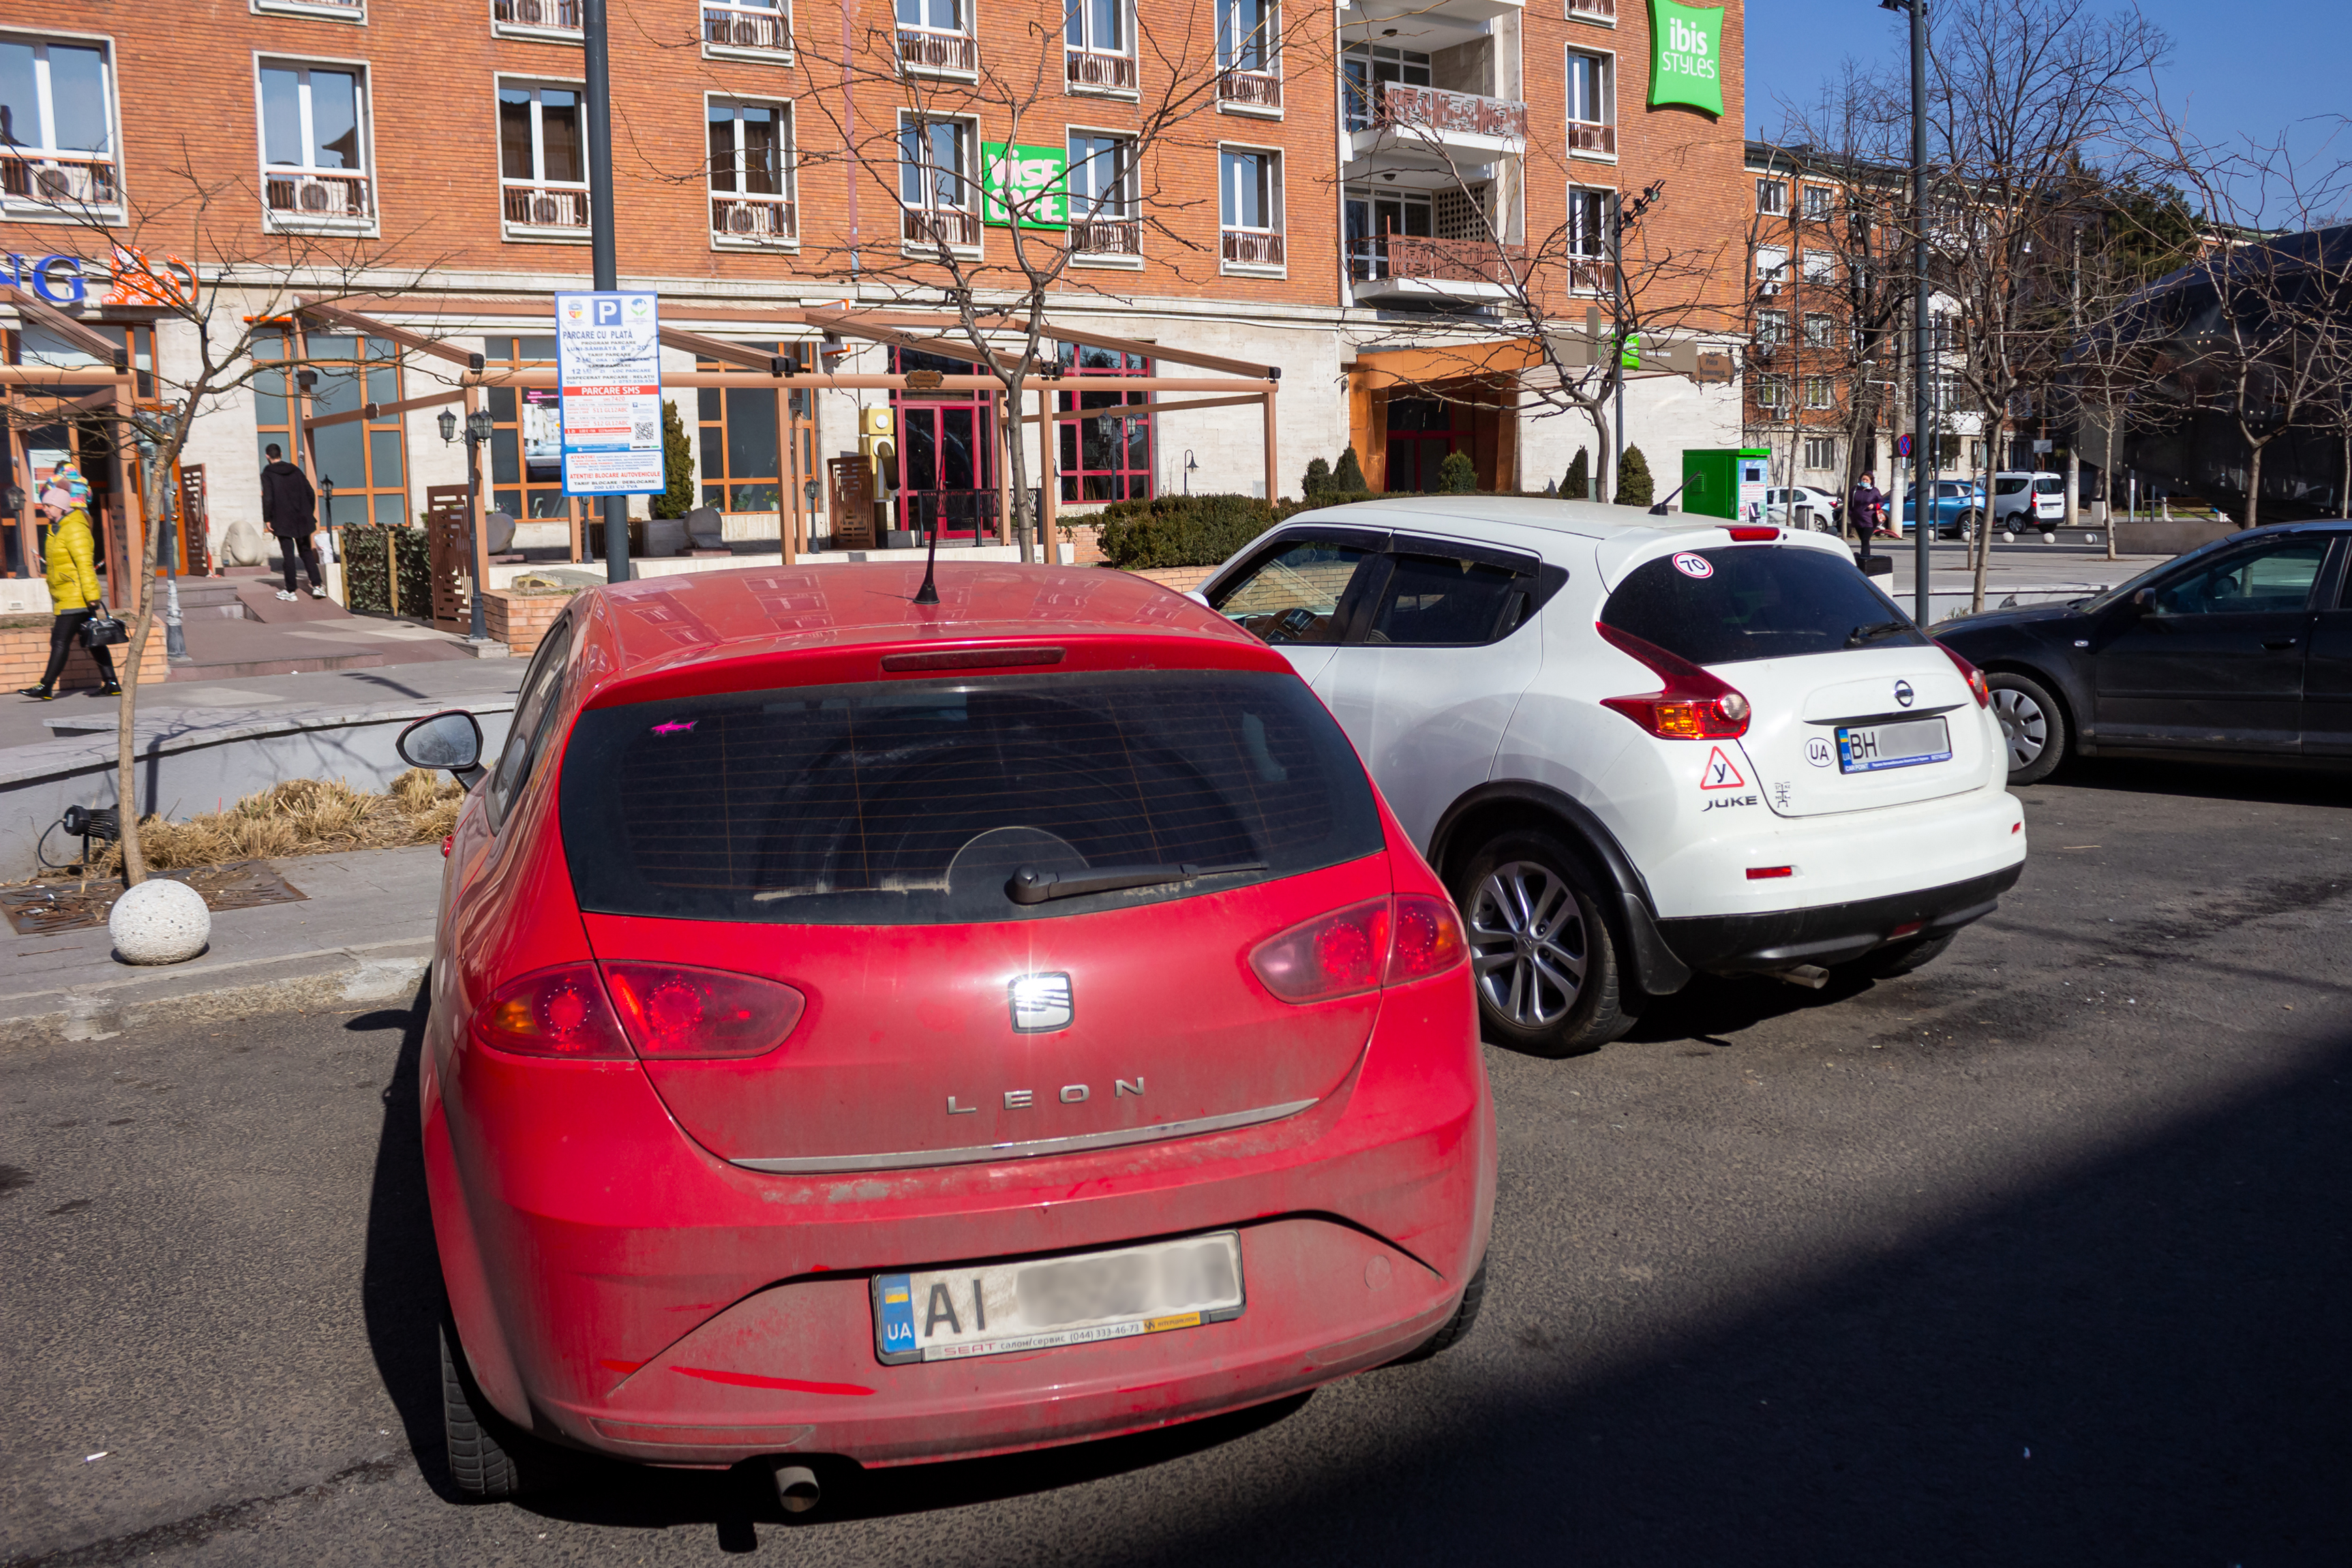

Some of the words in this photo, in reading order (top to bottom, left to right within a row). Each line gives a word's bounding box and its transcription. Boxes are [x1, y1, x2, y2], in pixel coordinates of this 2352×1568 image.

[1670, 17, 1708, 56] ibis
[599, 301, 617, 324] P
[1679, 558, 1706, 572] 70
[1809, 743, 1830, 761] UA
[1843, 753, 1852, 761] UA
[1850, 732, 1878, 759] BH
[1701, 796, 1758, 812] JUKE
[946, 1076, 1145, 1115] LEON
[924, 1278, 986, 1338] AI
[888, 1323, 912, 1342] UA
[944, 1342, 996, 1357] SEAT
[1000, 1334, 1066, 1351] салон/сервис
[1070, 1331, 1094, 1343] (044)
[1096, 1324, 1139, 1338] 333-46-73
